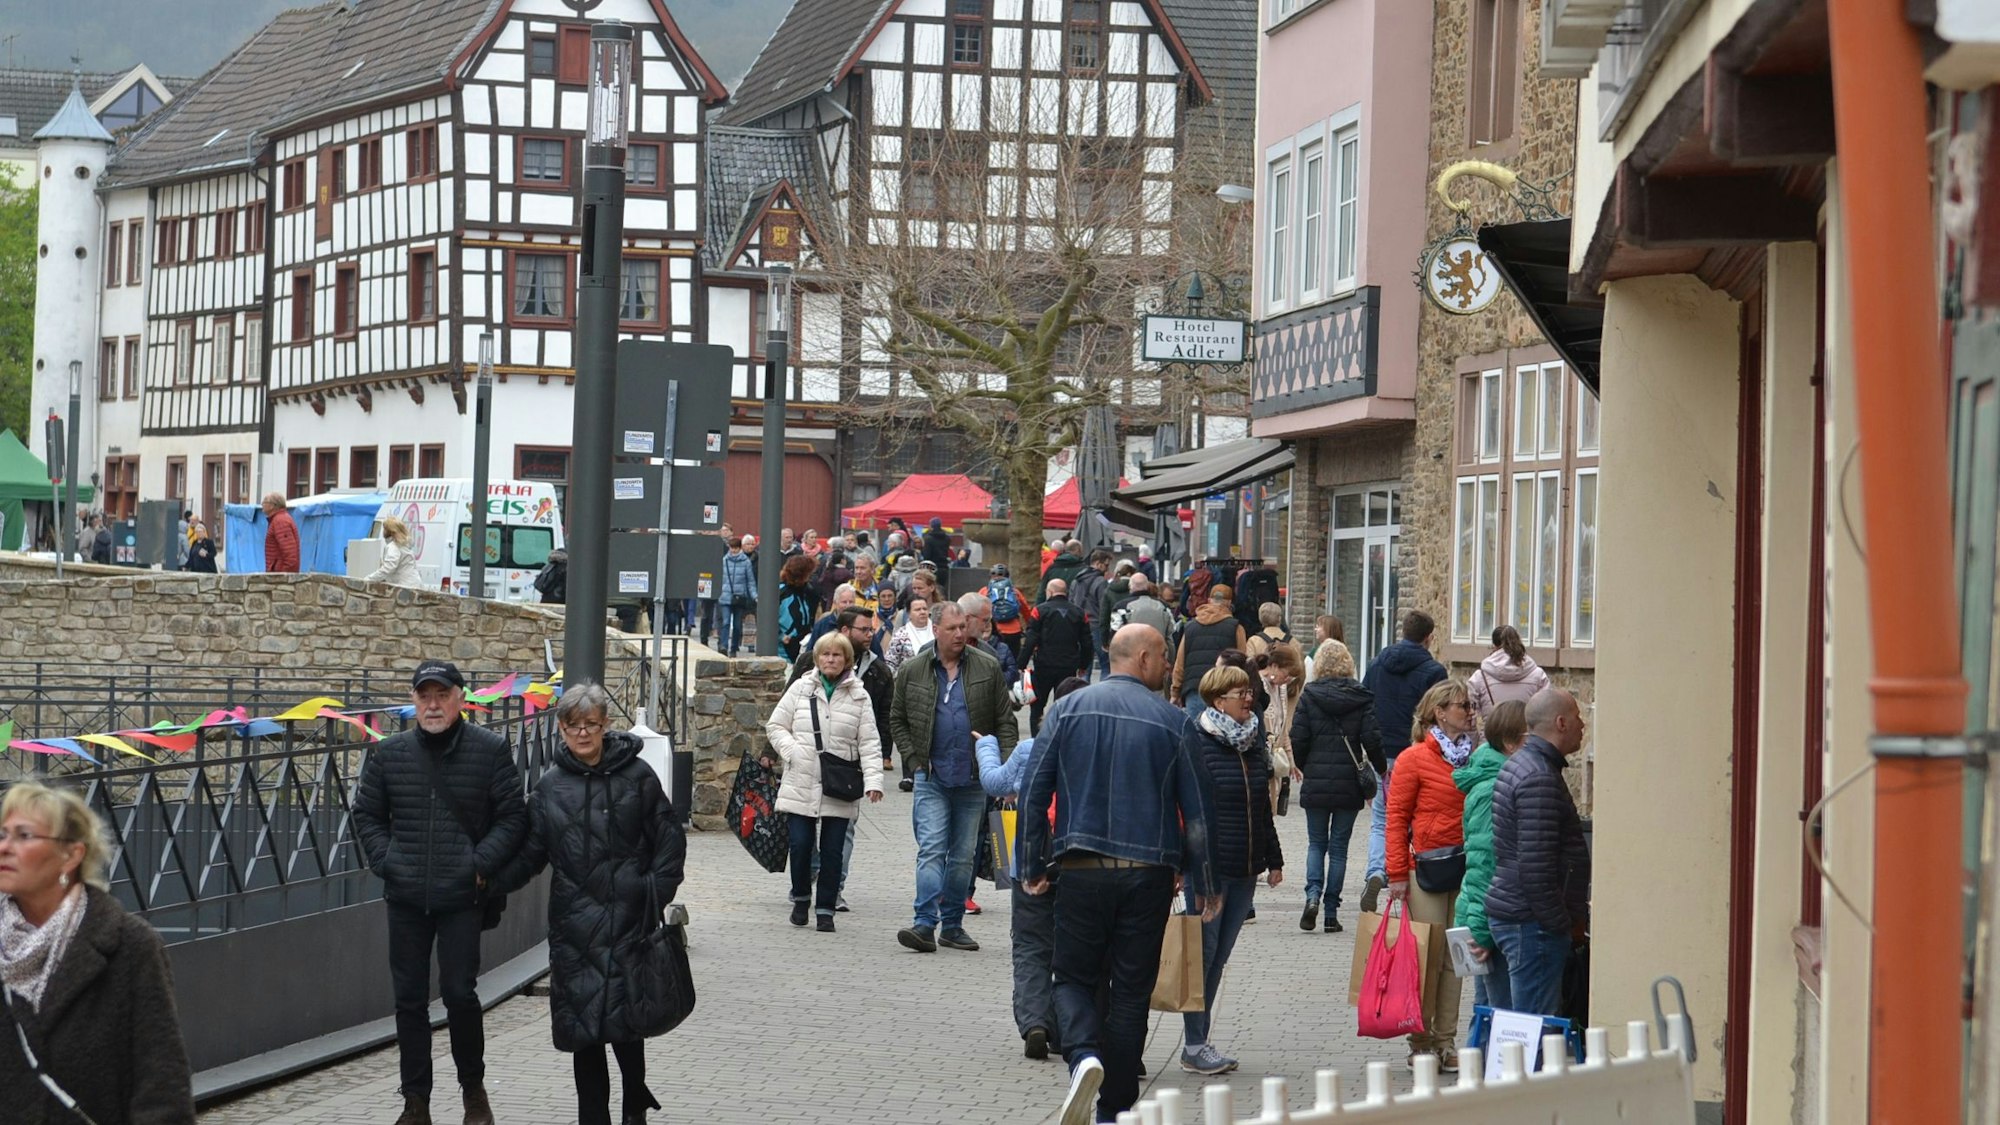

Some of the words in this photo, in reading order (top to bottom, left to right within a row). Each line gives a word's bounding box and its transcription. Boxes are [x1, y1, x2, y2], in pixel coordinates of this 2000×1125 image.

[1174, 320, 1215, 332] Hotel
[1155, 331, 1235, 344] Restaurant
[1171, 344, 1225, 358] Adler
[488, 484, 532, 496] TALIA
[487, 499, 527, 515] EIS
[992, 832, 1002, 869] SALAMANDER
